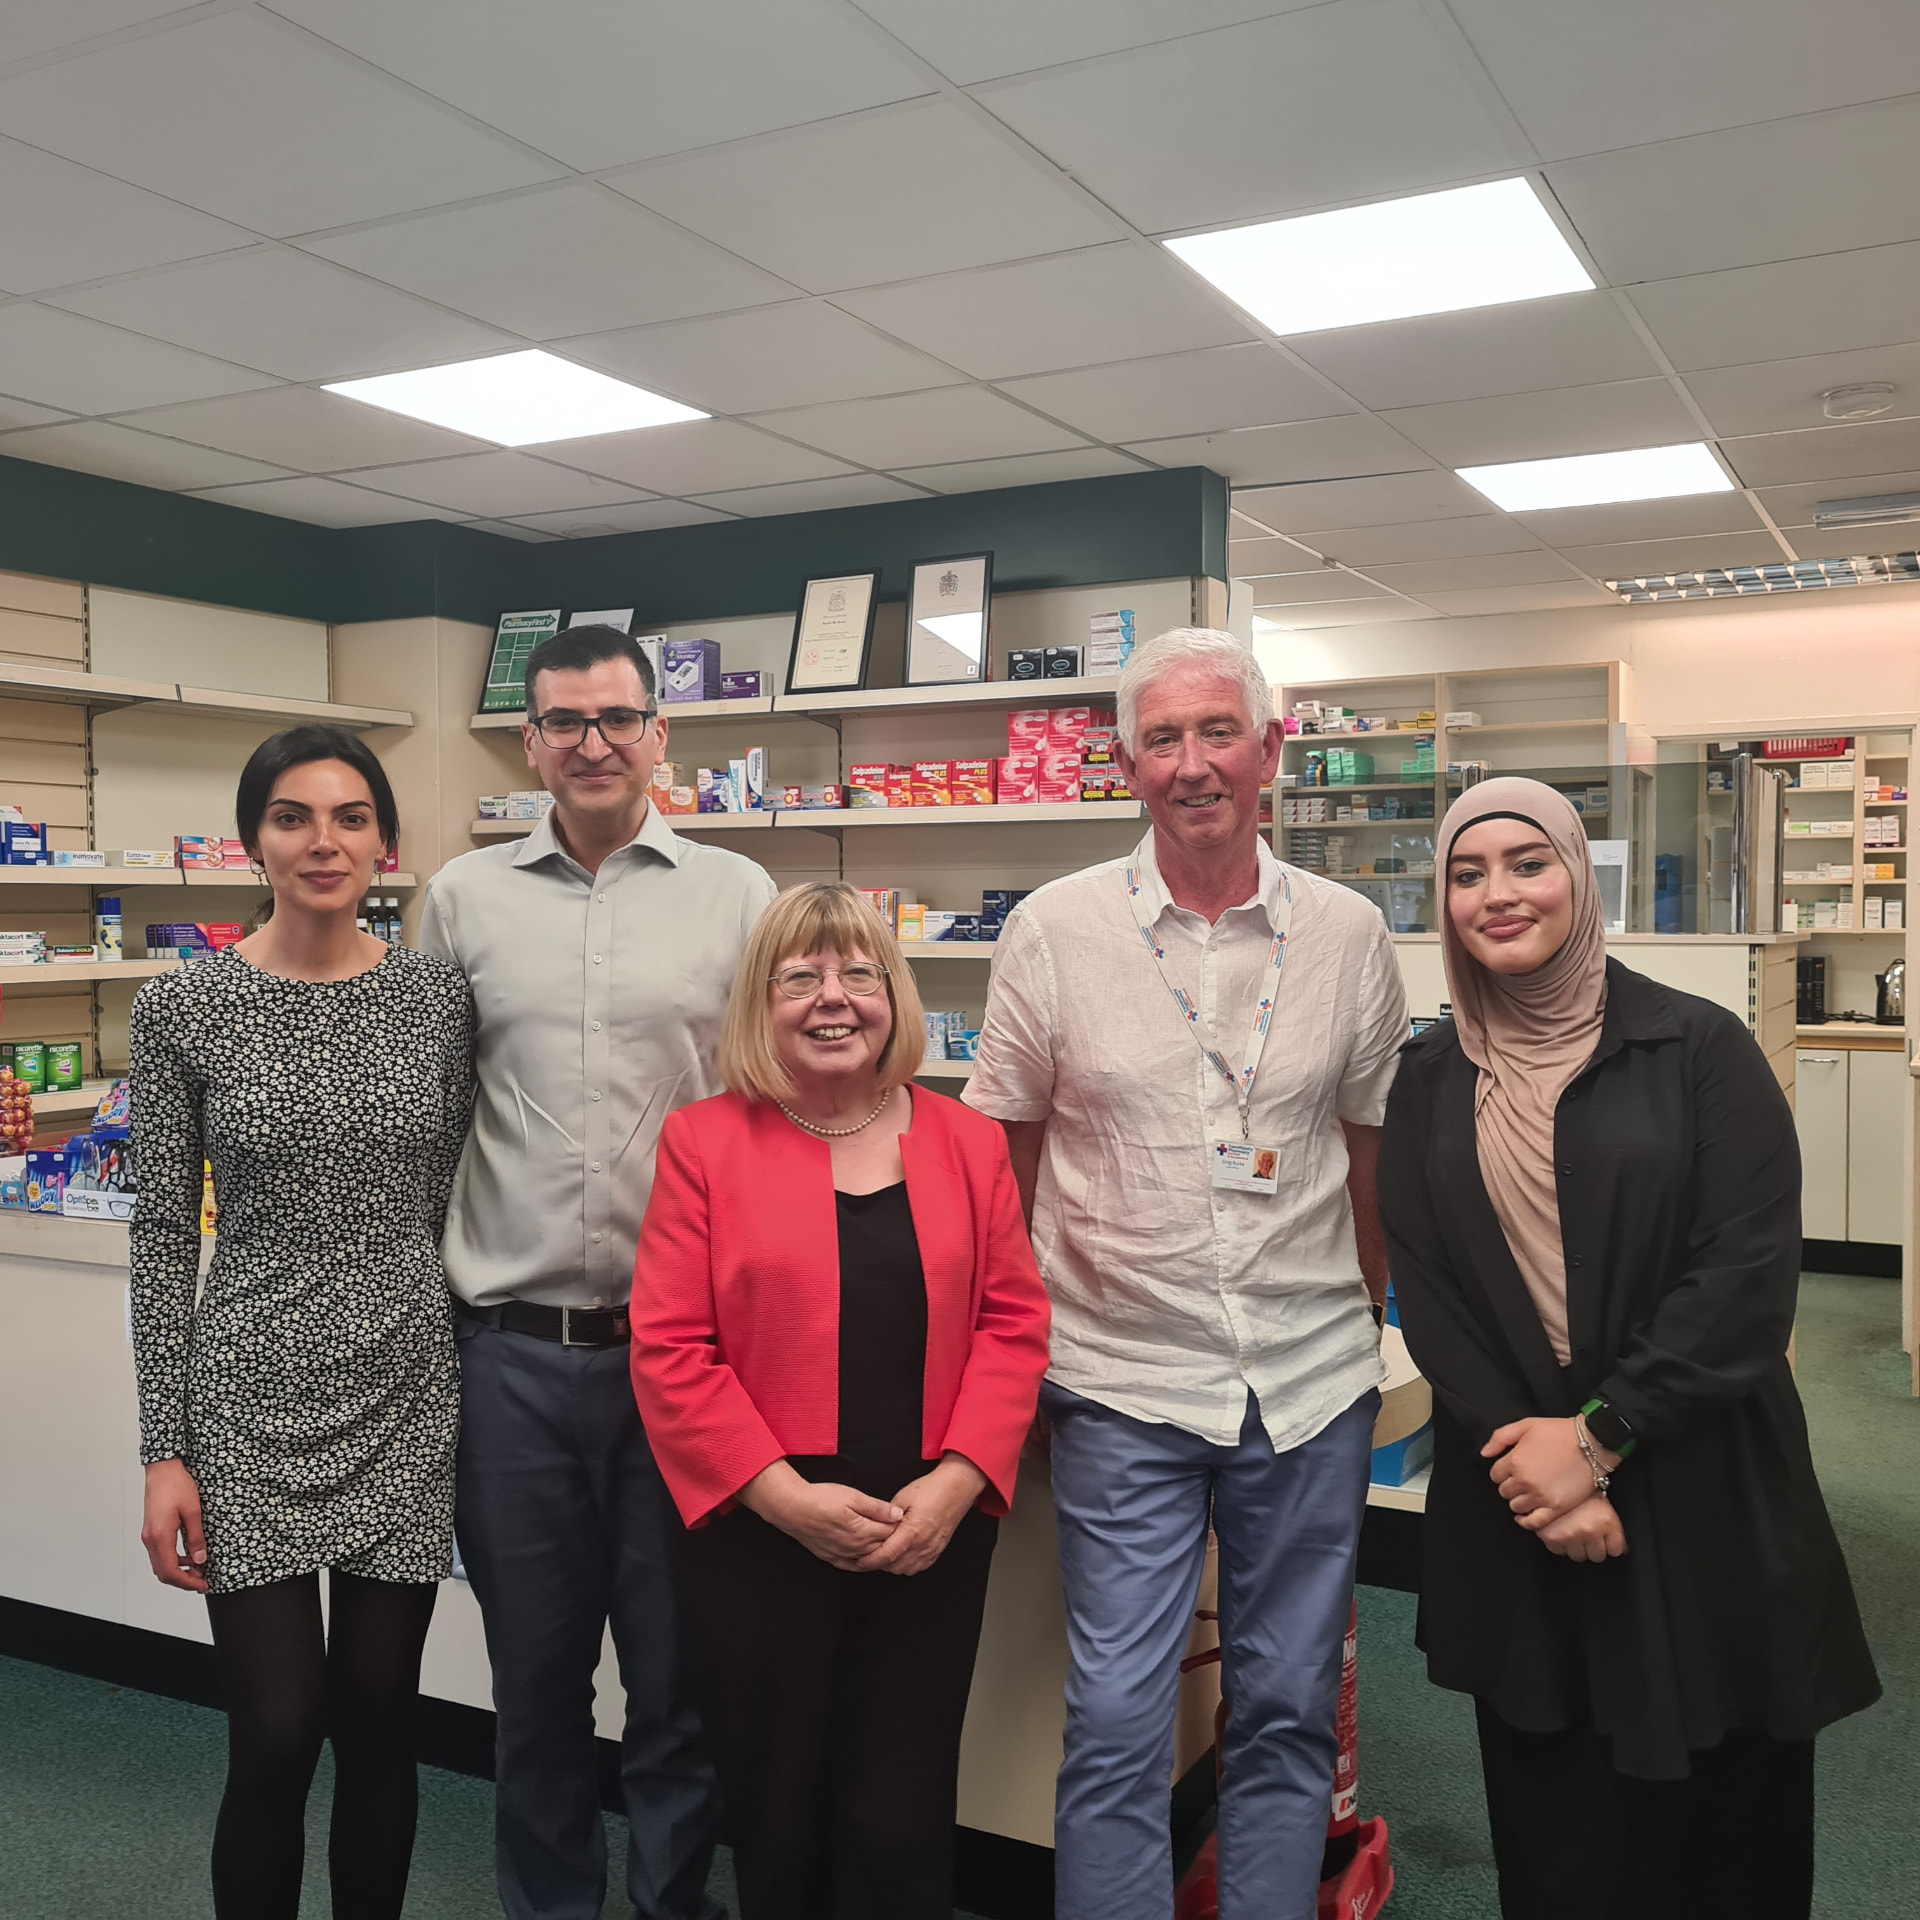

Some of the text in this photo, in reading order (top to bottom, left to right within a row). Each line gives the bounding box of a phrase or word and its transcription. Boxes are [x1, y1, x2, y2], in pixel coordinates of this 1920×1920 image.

[915, 763, 948, 772] Solpadeine
[955, 761, 989, 770] Solpadeine
[851, 766, 886, 776] Solpadeine
[49, 1045, 79, 1053] nicorette
